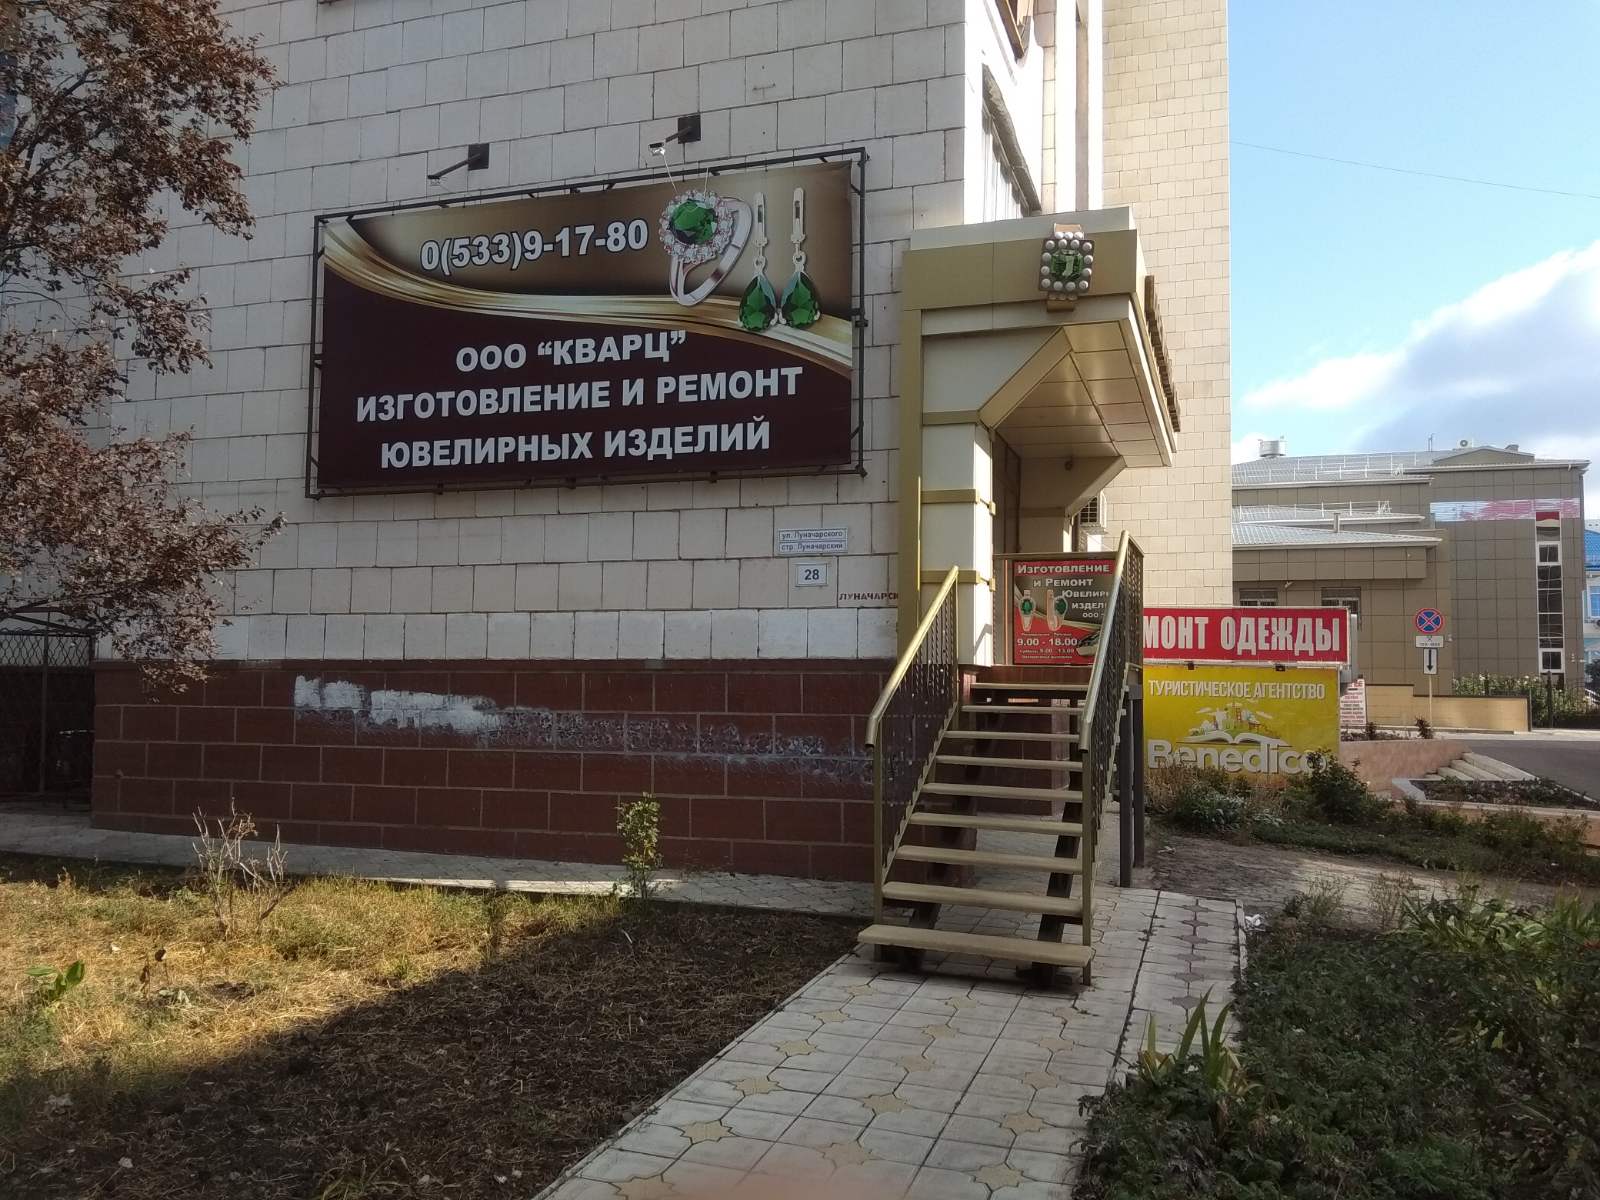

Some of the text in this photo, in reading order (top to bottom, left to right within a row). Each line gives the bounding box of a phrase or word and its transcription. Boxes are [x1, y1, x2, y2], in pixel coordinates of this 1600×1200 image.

[420, 218, 649, 276] 0(533)9-17-80
[455, 345, 526, 372] ООО
[356, 367, 803, 422] ИЗГОТОВЛЕНИЕ И РЕМОНТ
[380, 415, 771, 469] ЮВЕЛИРНЫХ ИЗДЕЛИЙ
[804, 568, 820, 580] 28
[1062, 589, 1109, 598] ЮВЕЛИР
[1071, 602, 1107, 610] ИЗДЕЛ
[1017, 638, 1039, 646] 9.00
[1048, 638, 1077, 646] 18.00
[1220, 616, 1341, 657] ОДЕЖДЫ
[1148, 679, 1325, 700] ТУРИСТИЧЕСКОЕ АГЕНТСТВО
